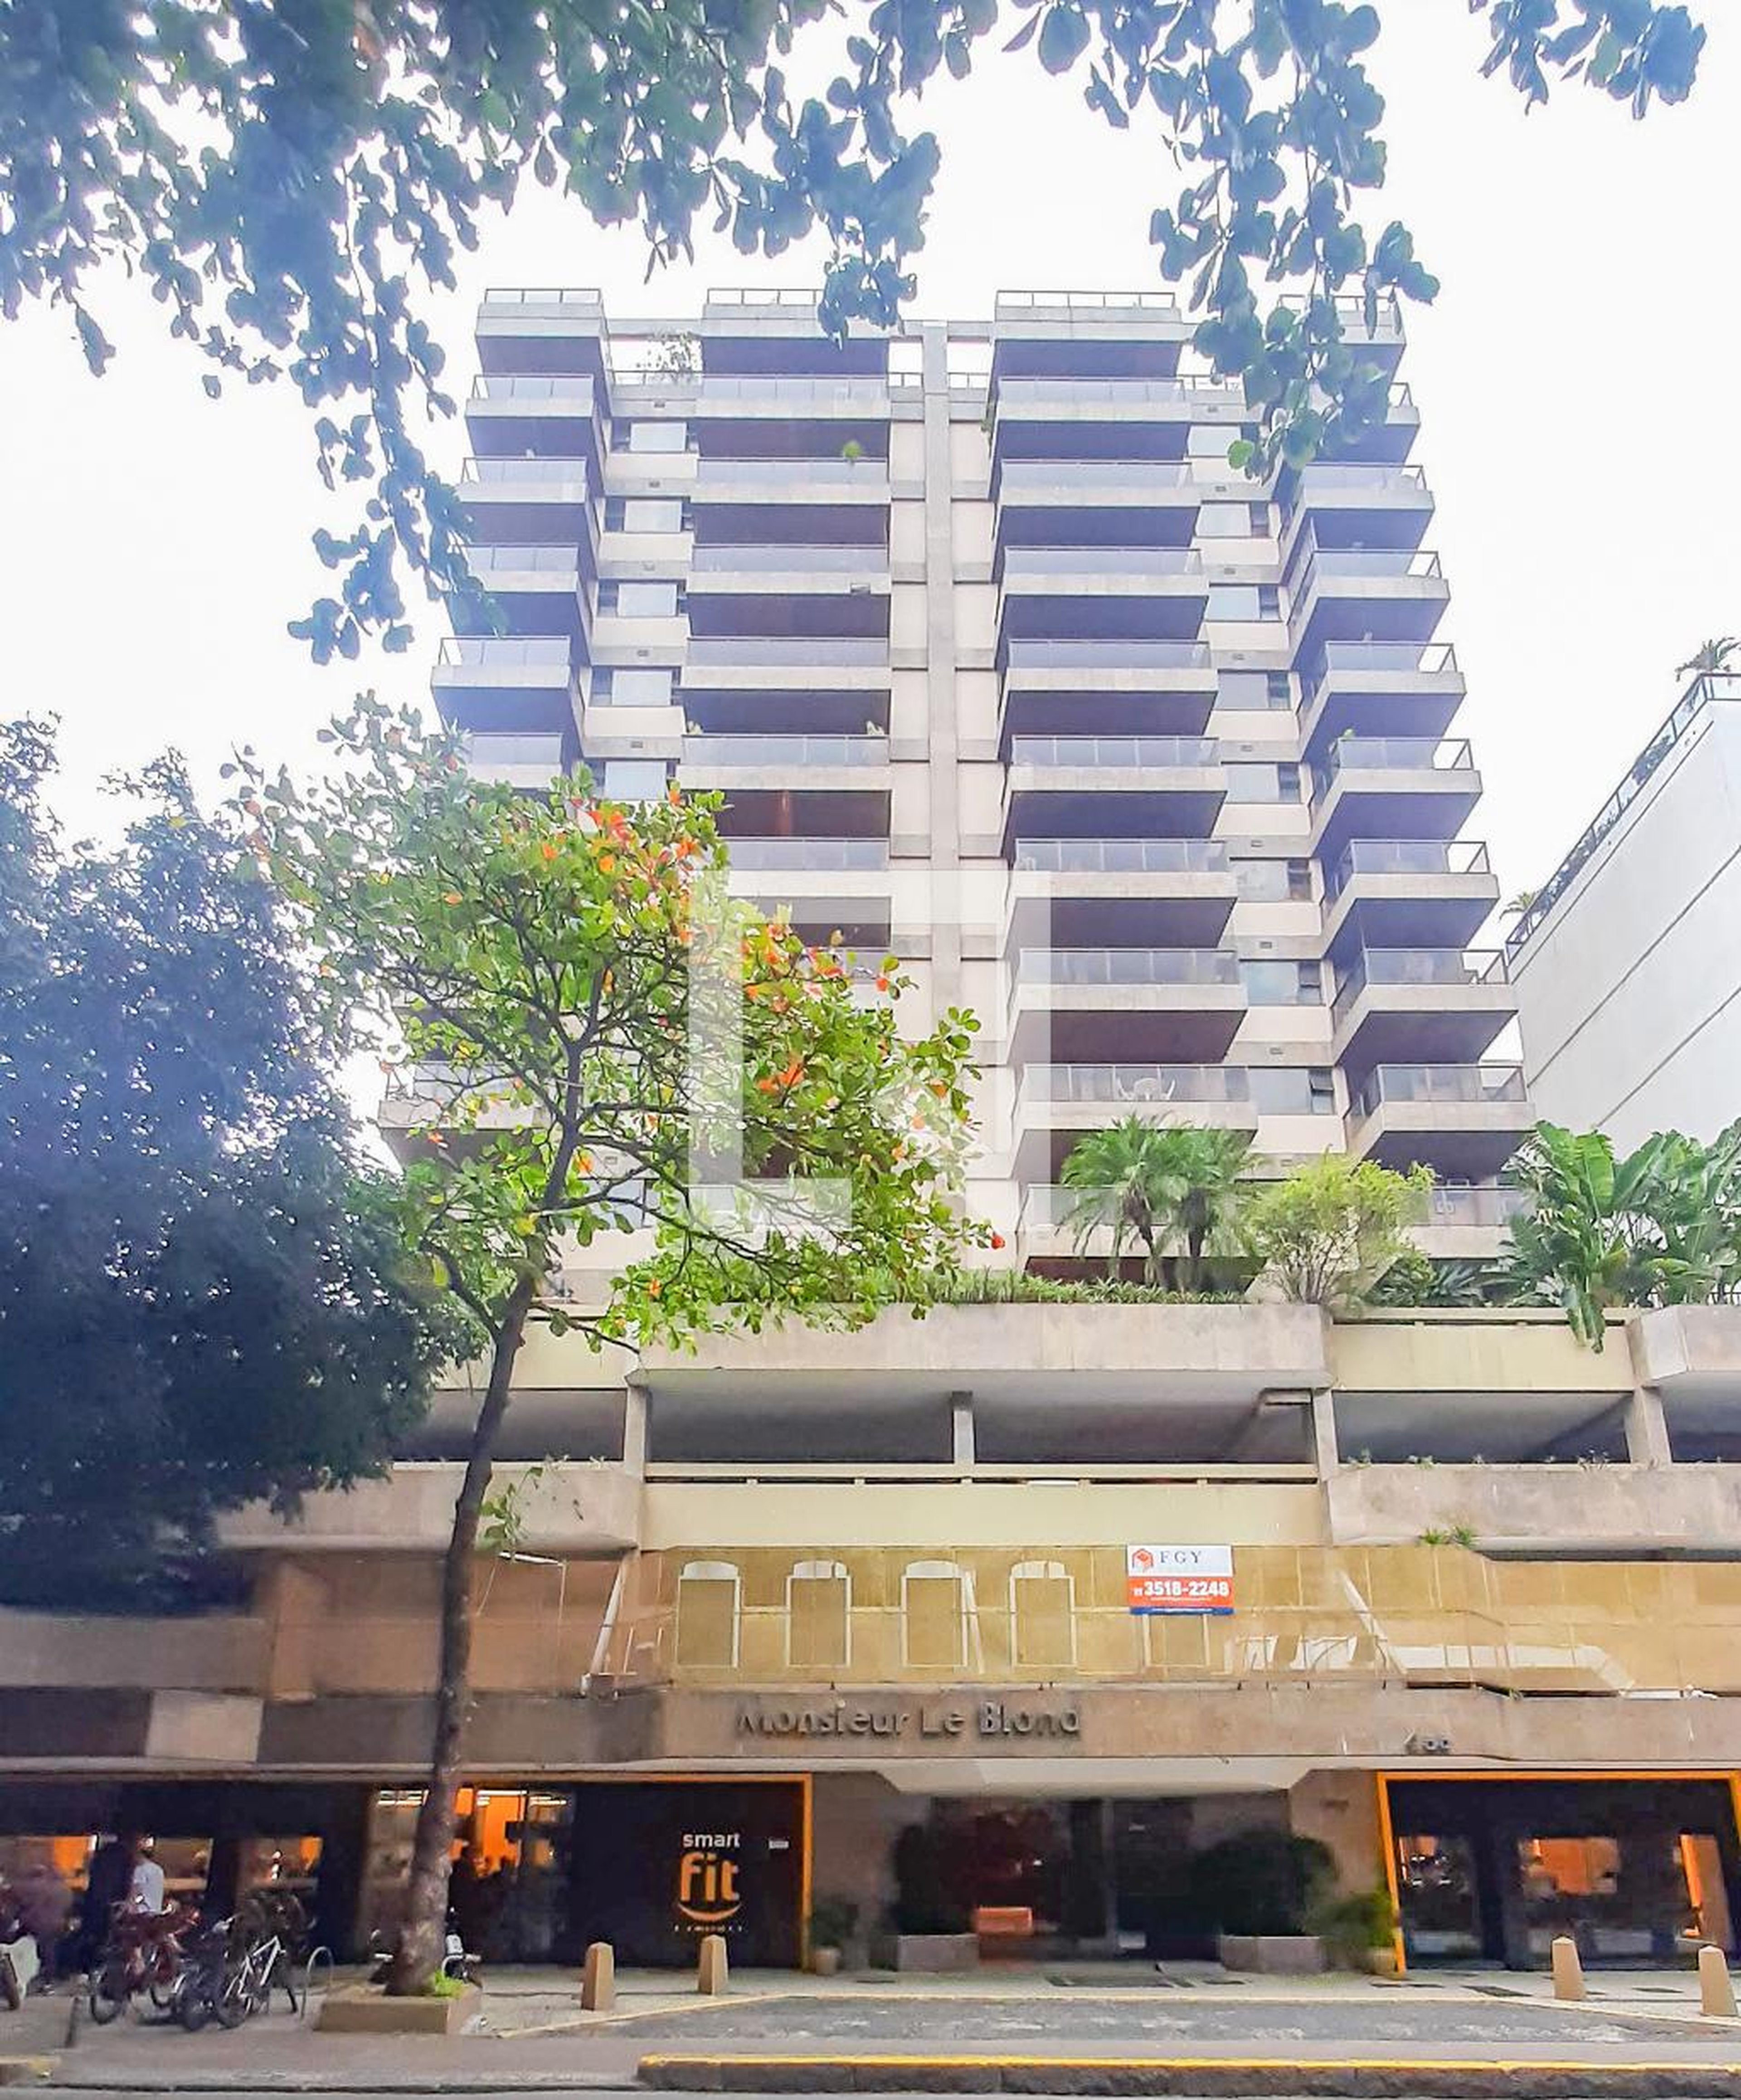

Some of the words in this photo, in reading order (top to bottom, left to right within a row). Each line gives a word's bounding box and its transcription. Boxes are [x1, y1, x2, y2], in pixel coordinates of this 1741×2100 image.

[1144, 1581, 1230, 1596] 3518-2248
[737, 1699, 909, 1734] Monsieur
[920, 1705, 965, 1735] Le
[683, 1833, 740, 1848] smart
[681, 1852, 740, 1901] fit
